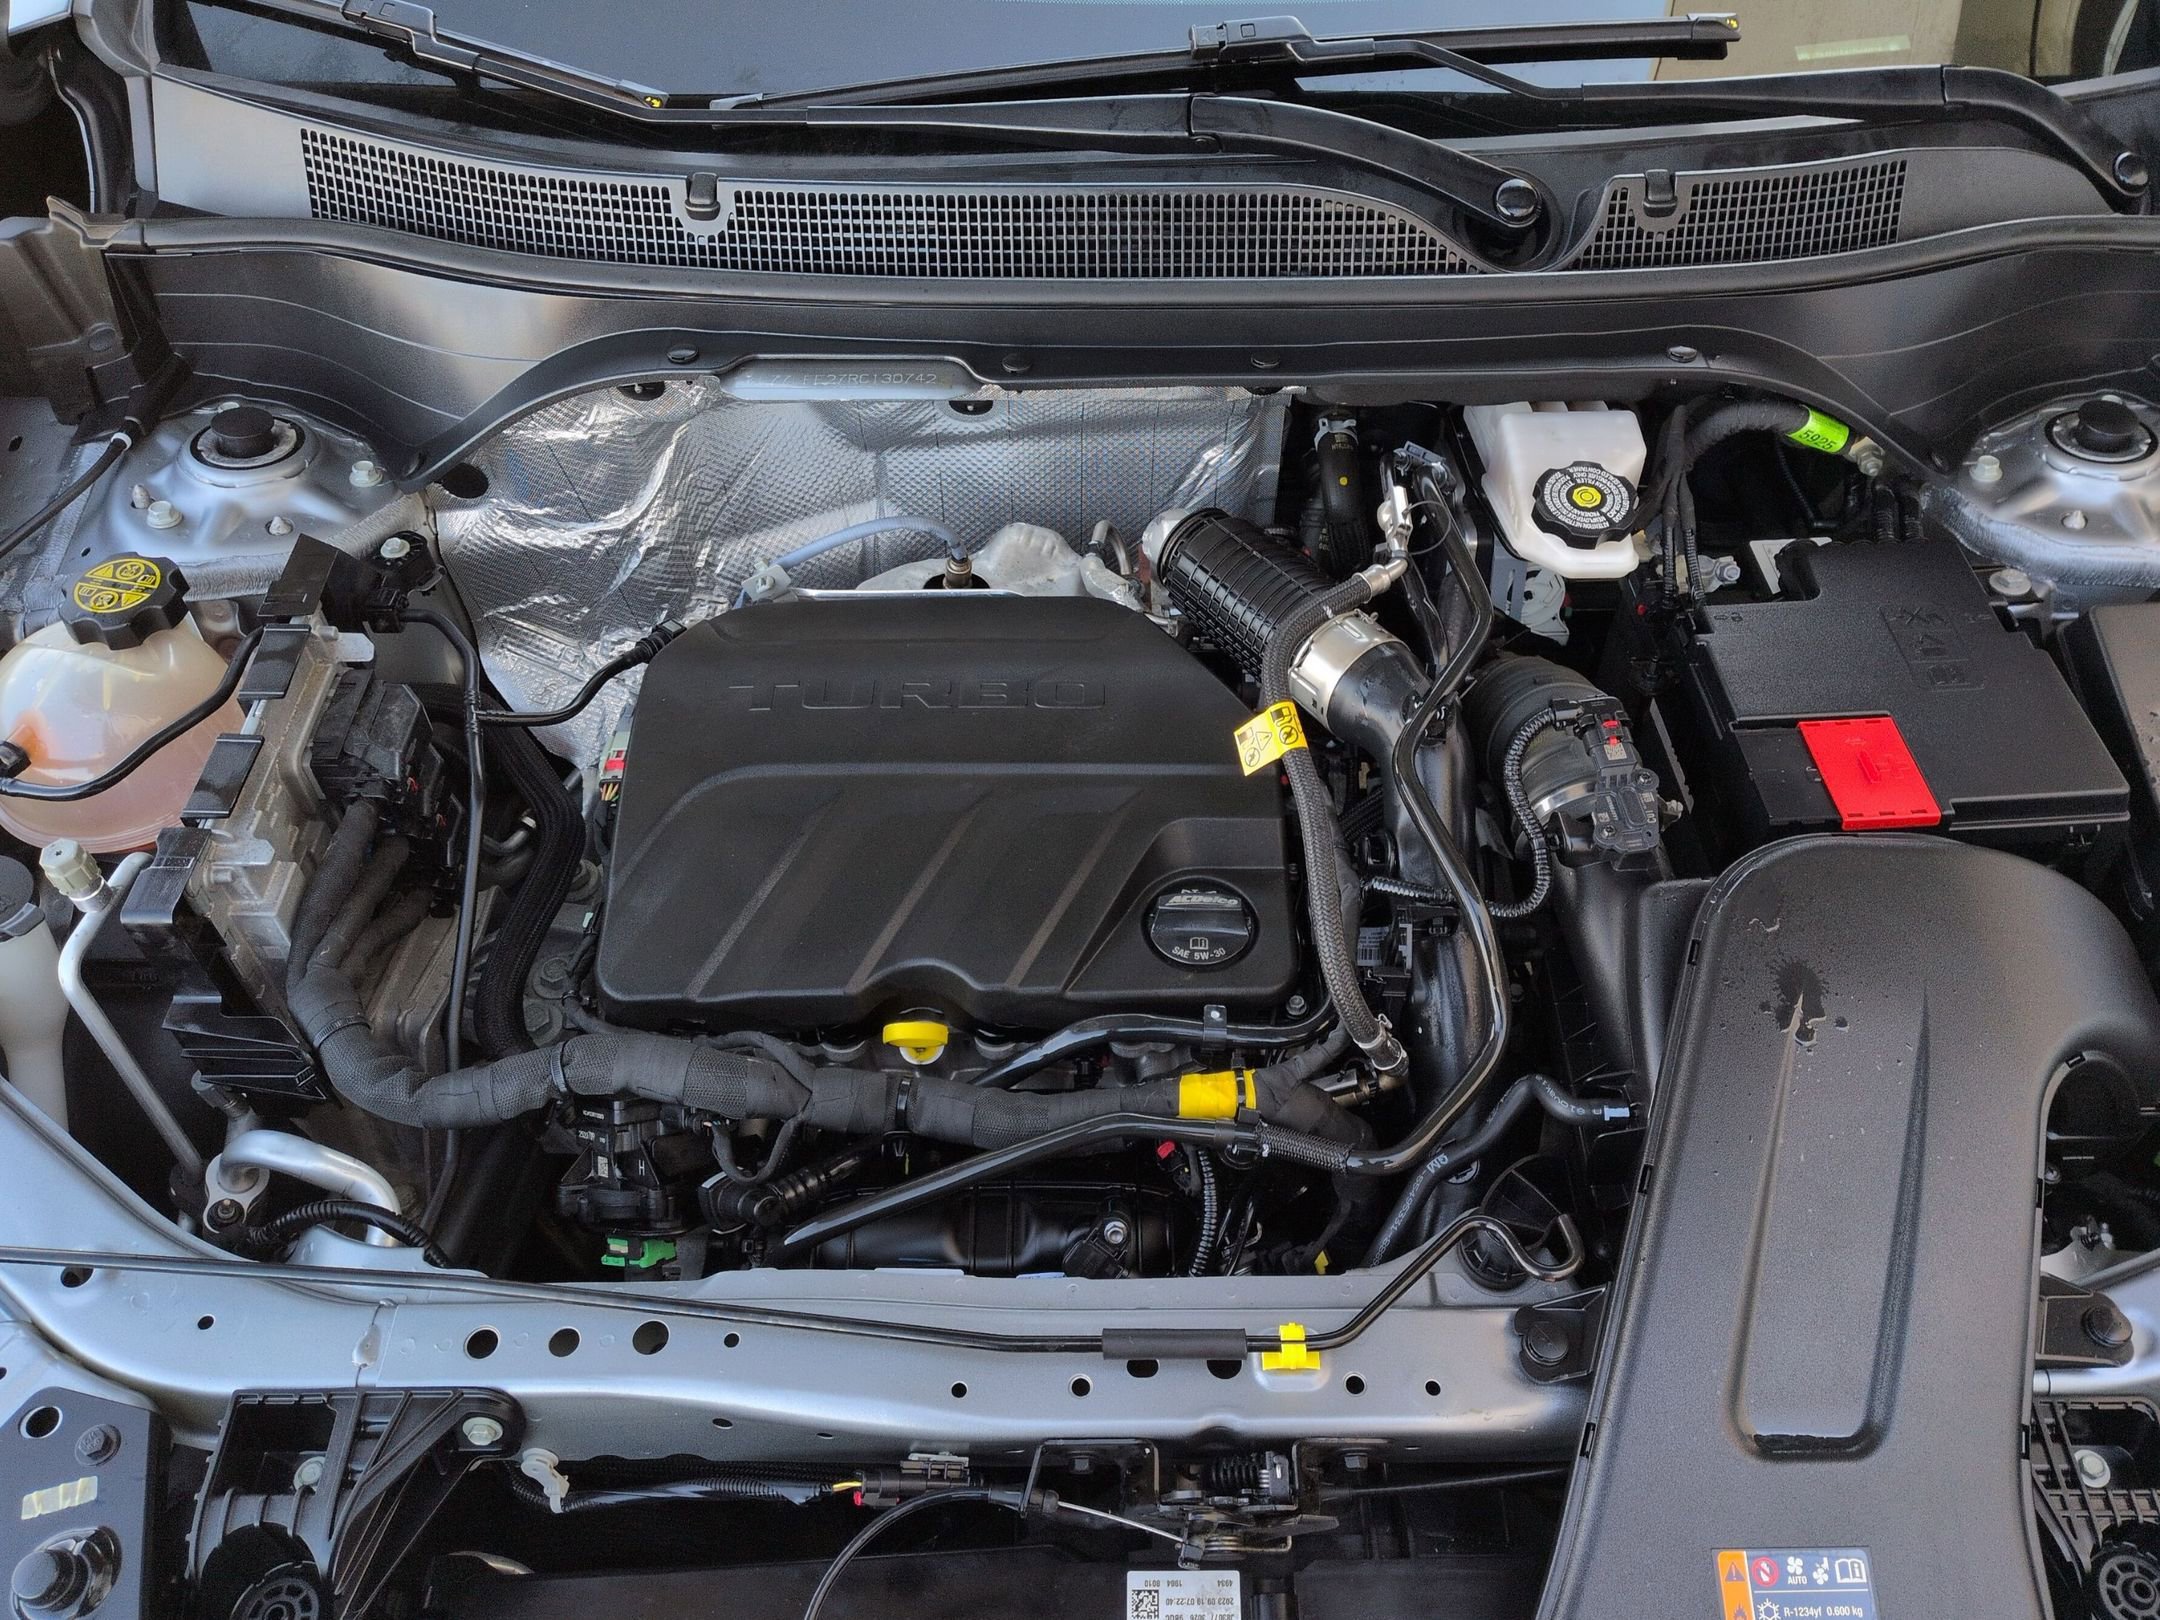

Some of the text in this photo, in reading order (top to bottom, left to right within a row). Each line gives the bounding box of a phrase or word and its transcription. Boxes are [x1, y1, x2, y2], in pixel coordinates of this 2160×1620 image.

[728, 679, 1107, 711] TURBO
[1166, 895, 1239, 906] ACDelco
[1172, 946, 1226, 960] SAE 5W-30
[1788, 1576, 1808, 1585] AUTO
[1783, 1605, 1864, 1619] R-1234yf 0.600 kg
